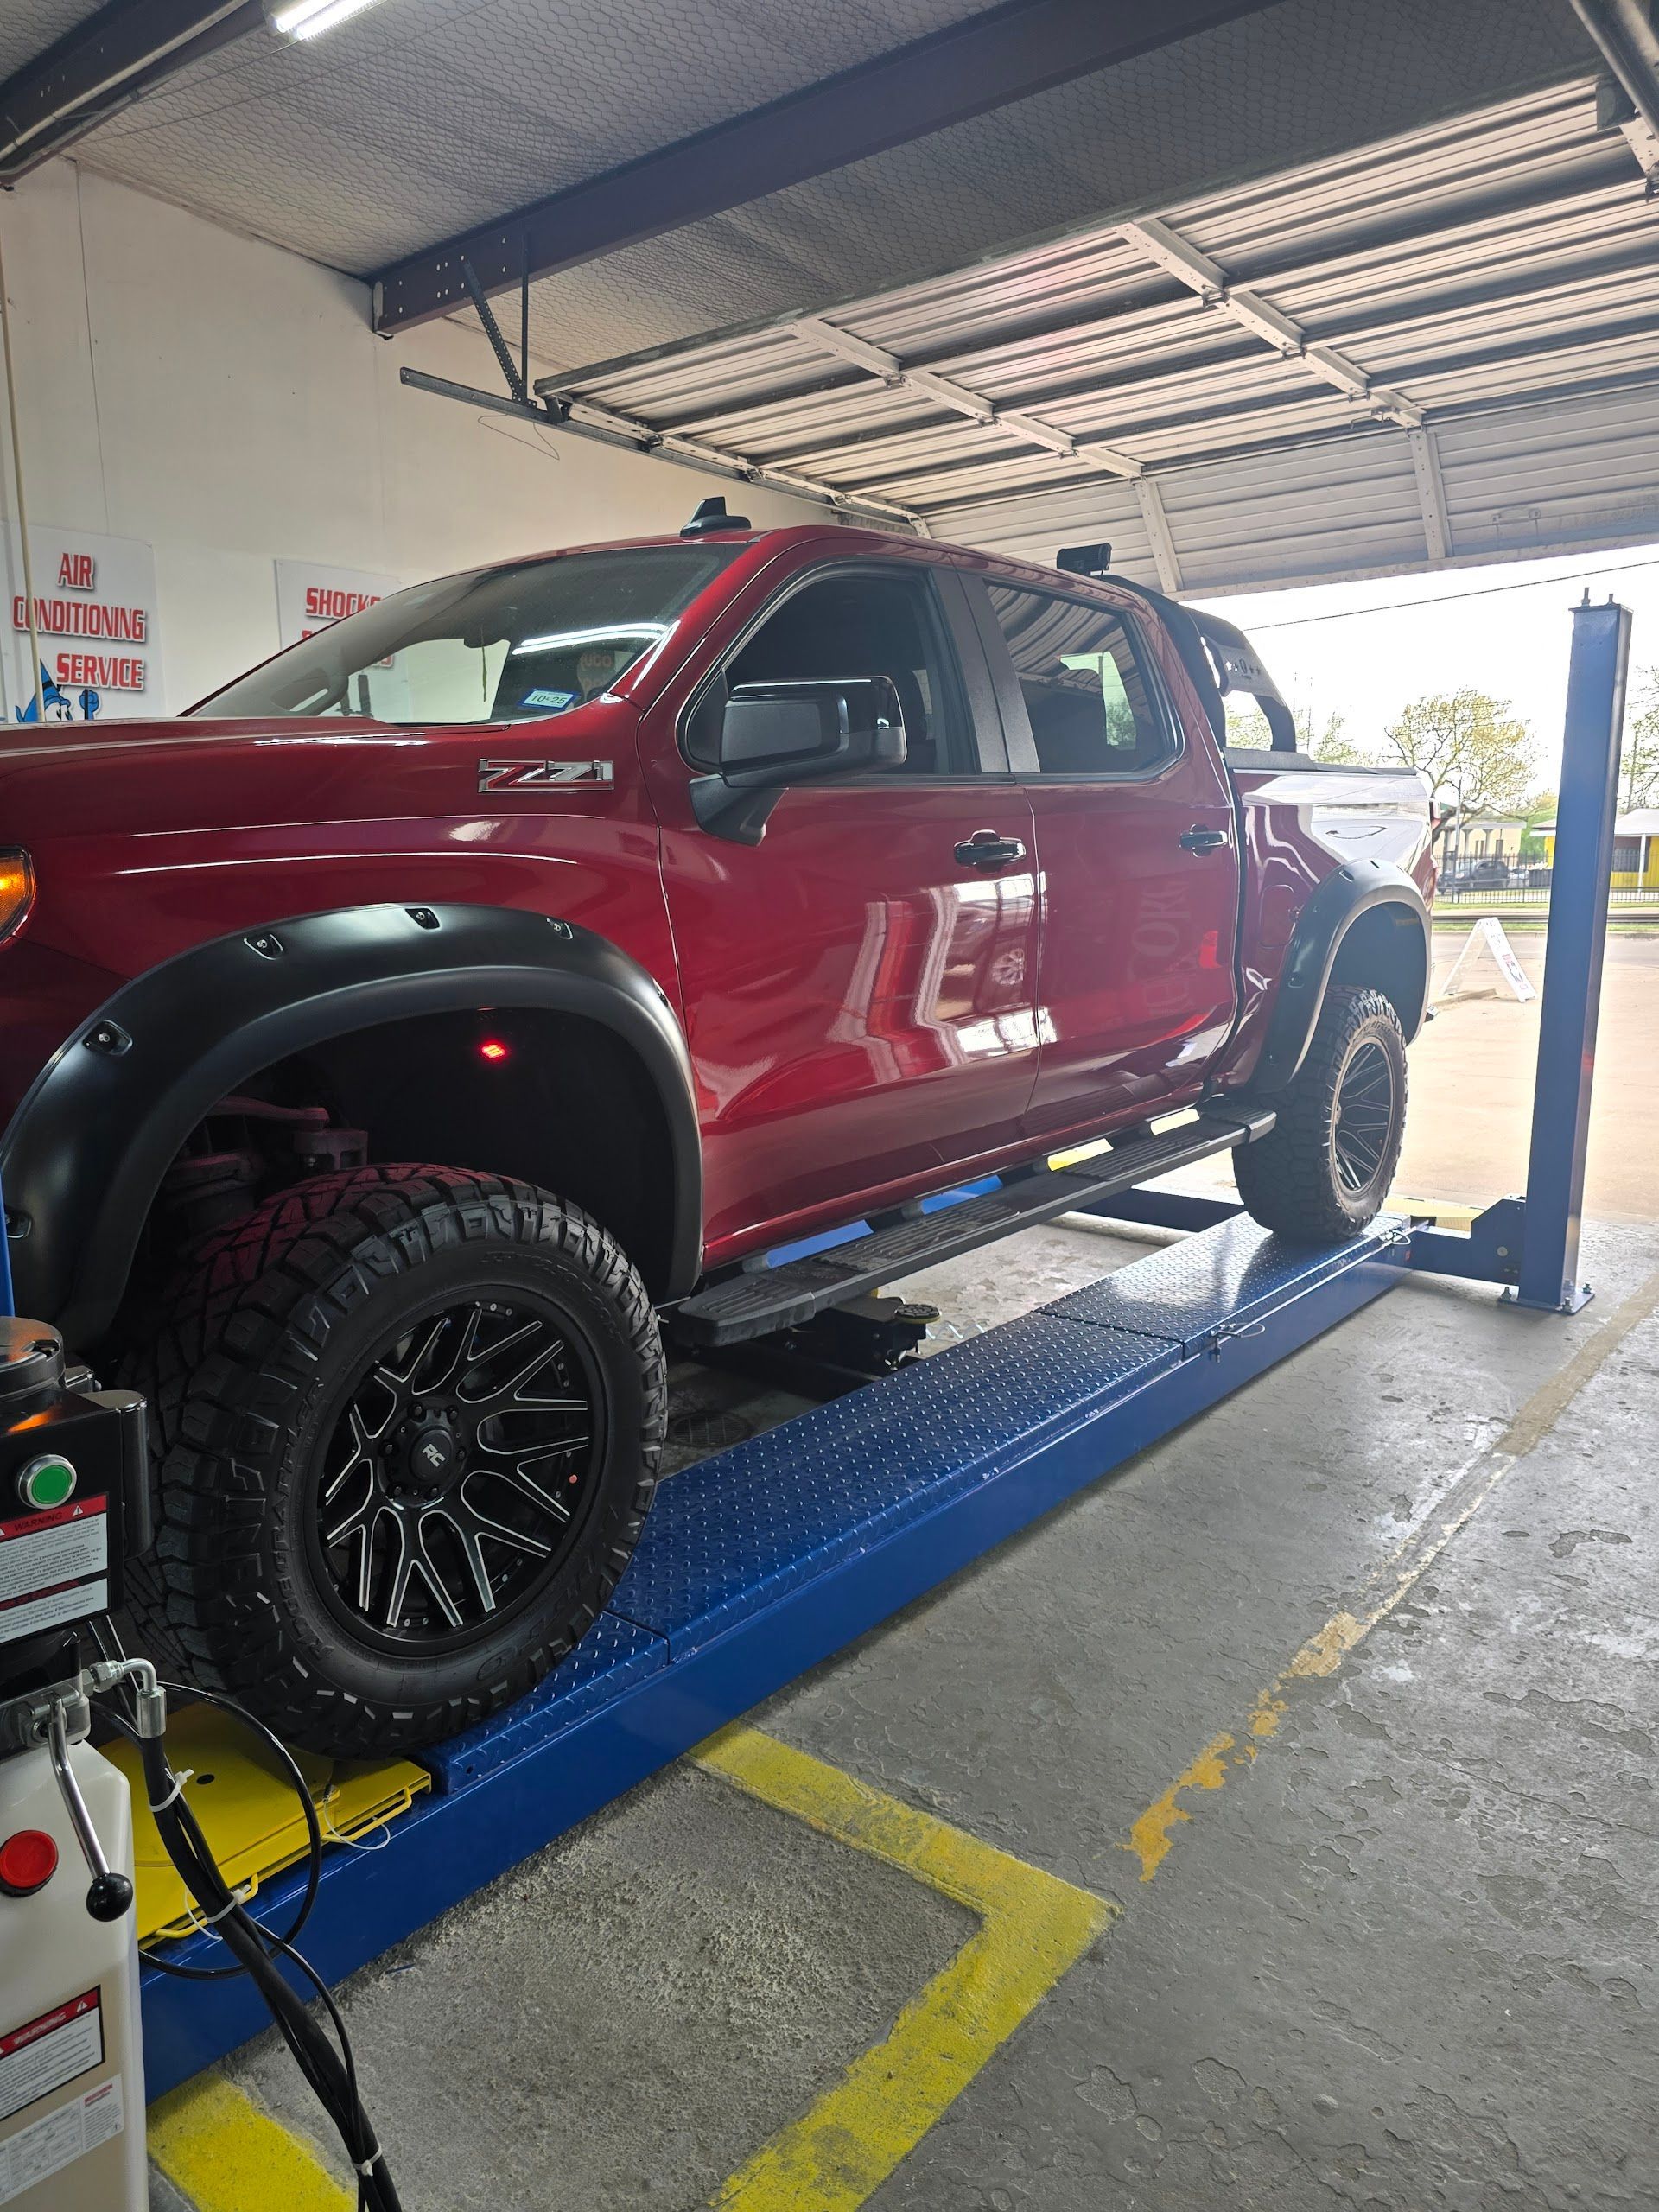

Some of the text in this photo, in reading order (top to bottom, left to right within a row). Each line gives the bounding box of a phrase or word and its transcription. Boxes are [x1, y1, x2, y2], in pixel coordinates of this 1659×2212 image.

[58, 552, 93, 588] AIR
[56, 653, 143, 690] SERVICE
[478, 758, 614, 793] Z71
[421, 1443, 446, 1468] RC
[14, 1511, 63, 1532] WARNING
